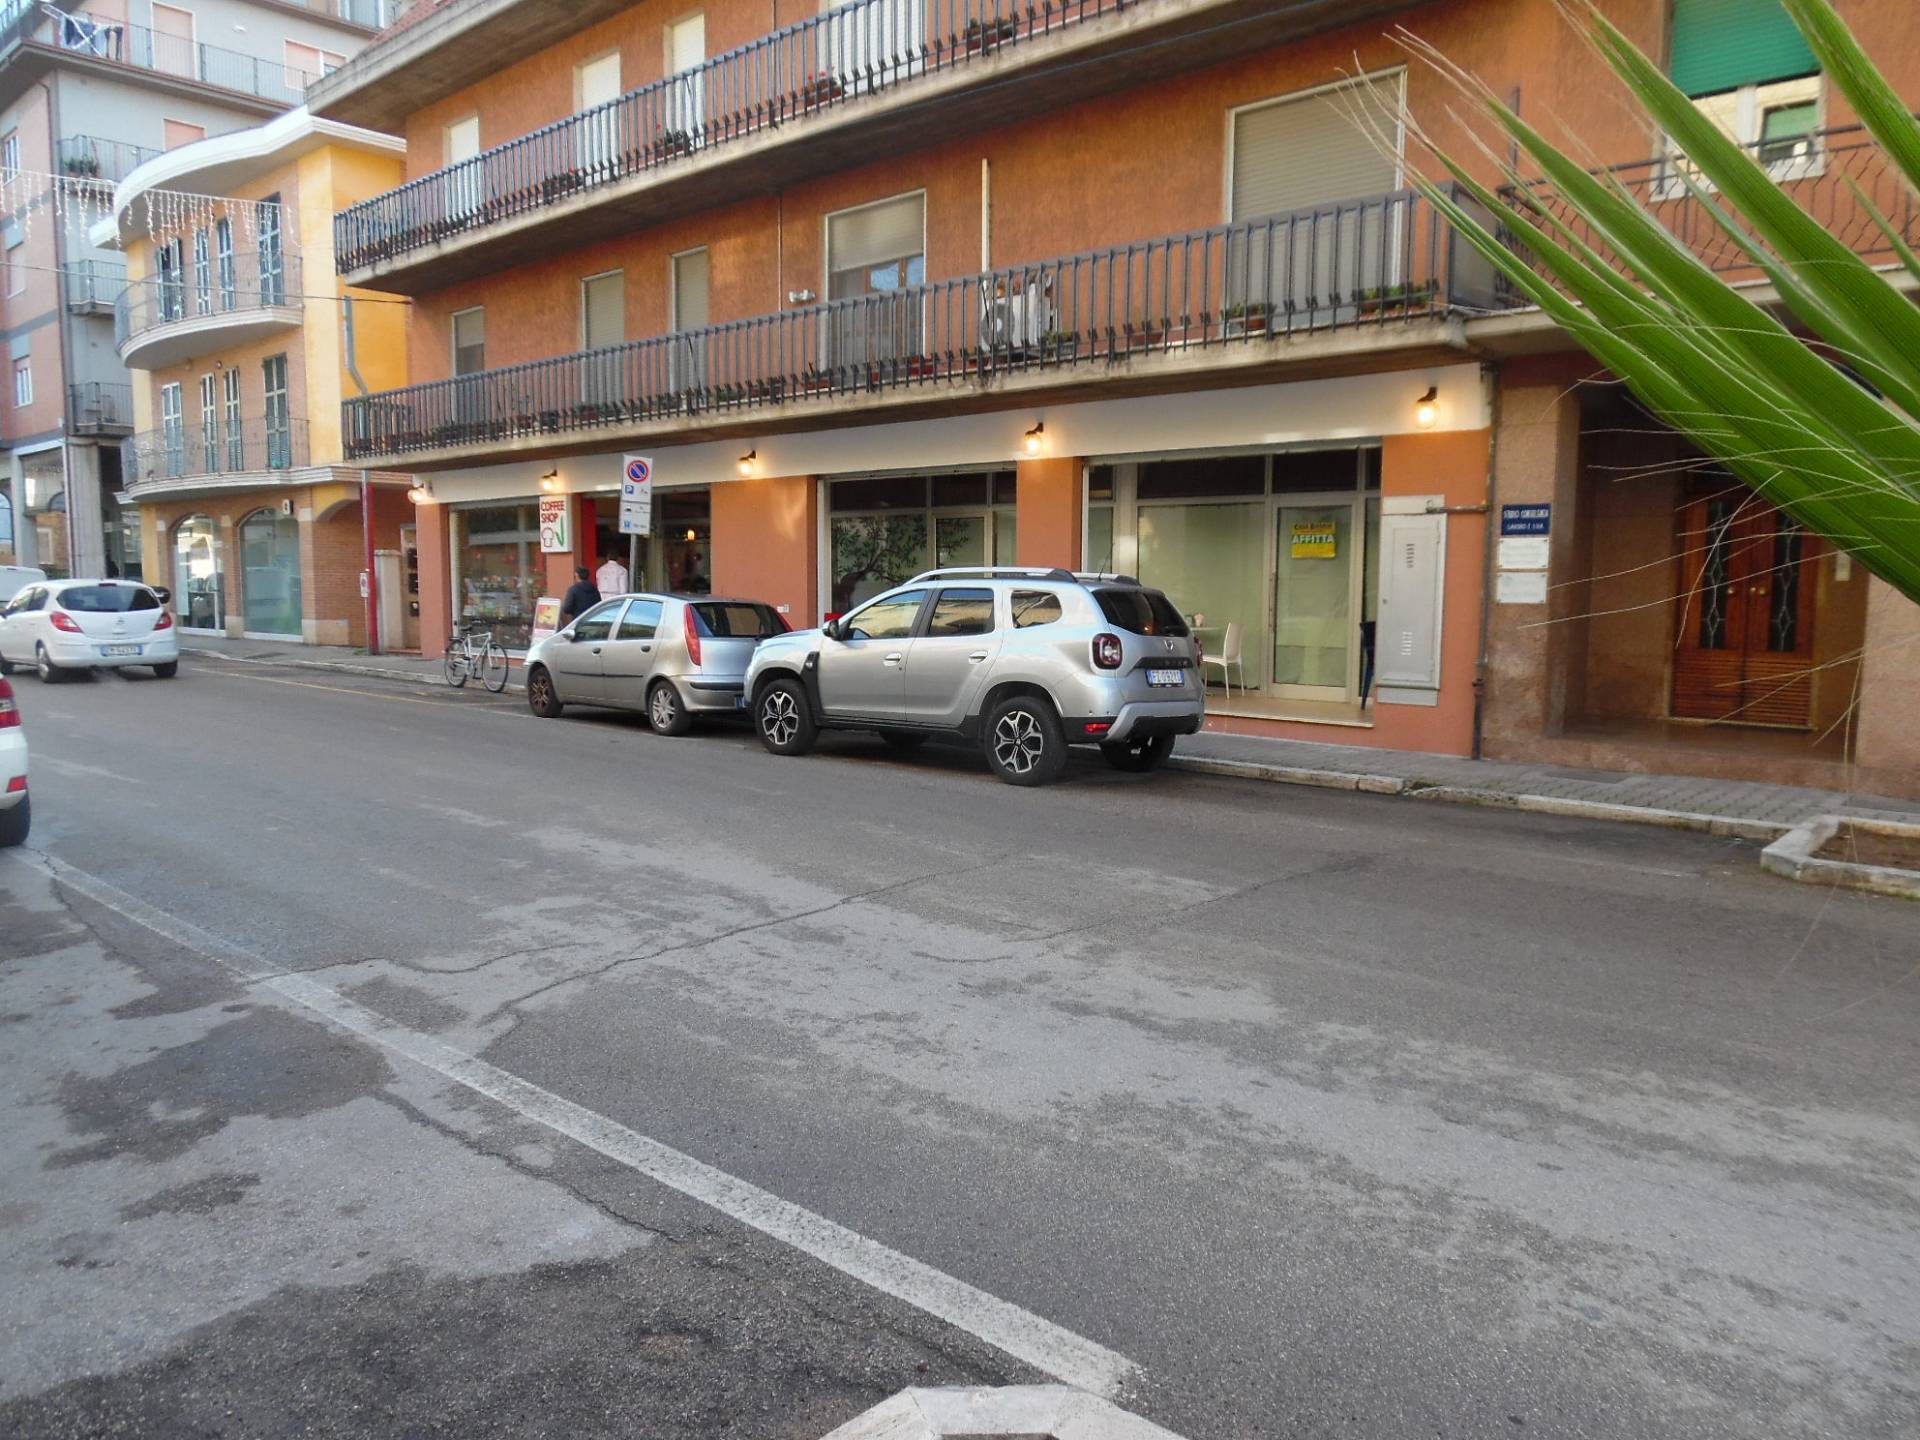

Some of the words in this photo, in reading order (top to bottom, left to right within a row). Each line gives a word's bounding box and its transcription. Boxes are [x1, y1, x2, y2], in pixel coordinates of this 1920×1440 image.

[541, 500, 565, 511] COFFEE
[541, 513, 558, 523] SHOP
[1292, 534, 1335, 544] AFFITTA
